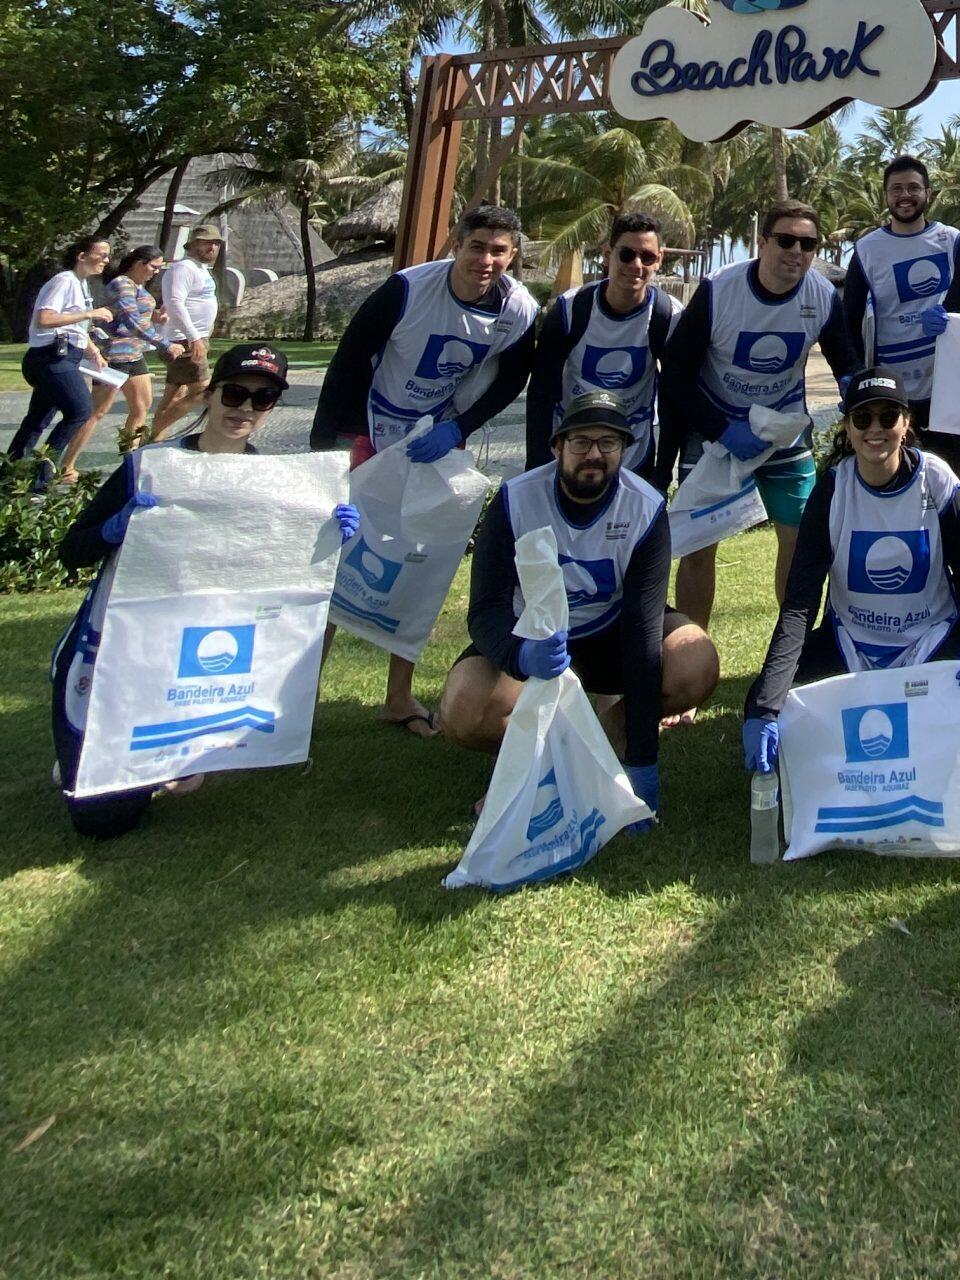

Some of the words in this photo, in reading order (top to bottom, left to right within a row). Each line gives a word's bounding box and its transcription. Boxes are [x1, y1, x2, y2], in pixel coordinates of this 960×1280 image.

[631, 29, 773, 97] Beach
[904, 607, 931, 624] Azul
[167, 685, 225, 701] Bandeira
[227, 681, 255, 696] Azul
[838, 770, 886, 785] Bandeira
[889, 767, 916, 784] Azul
